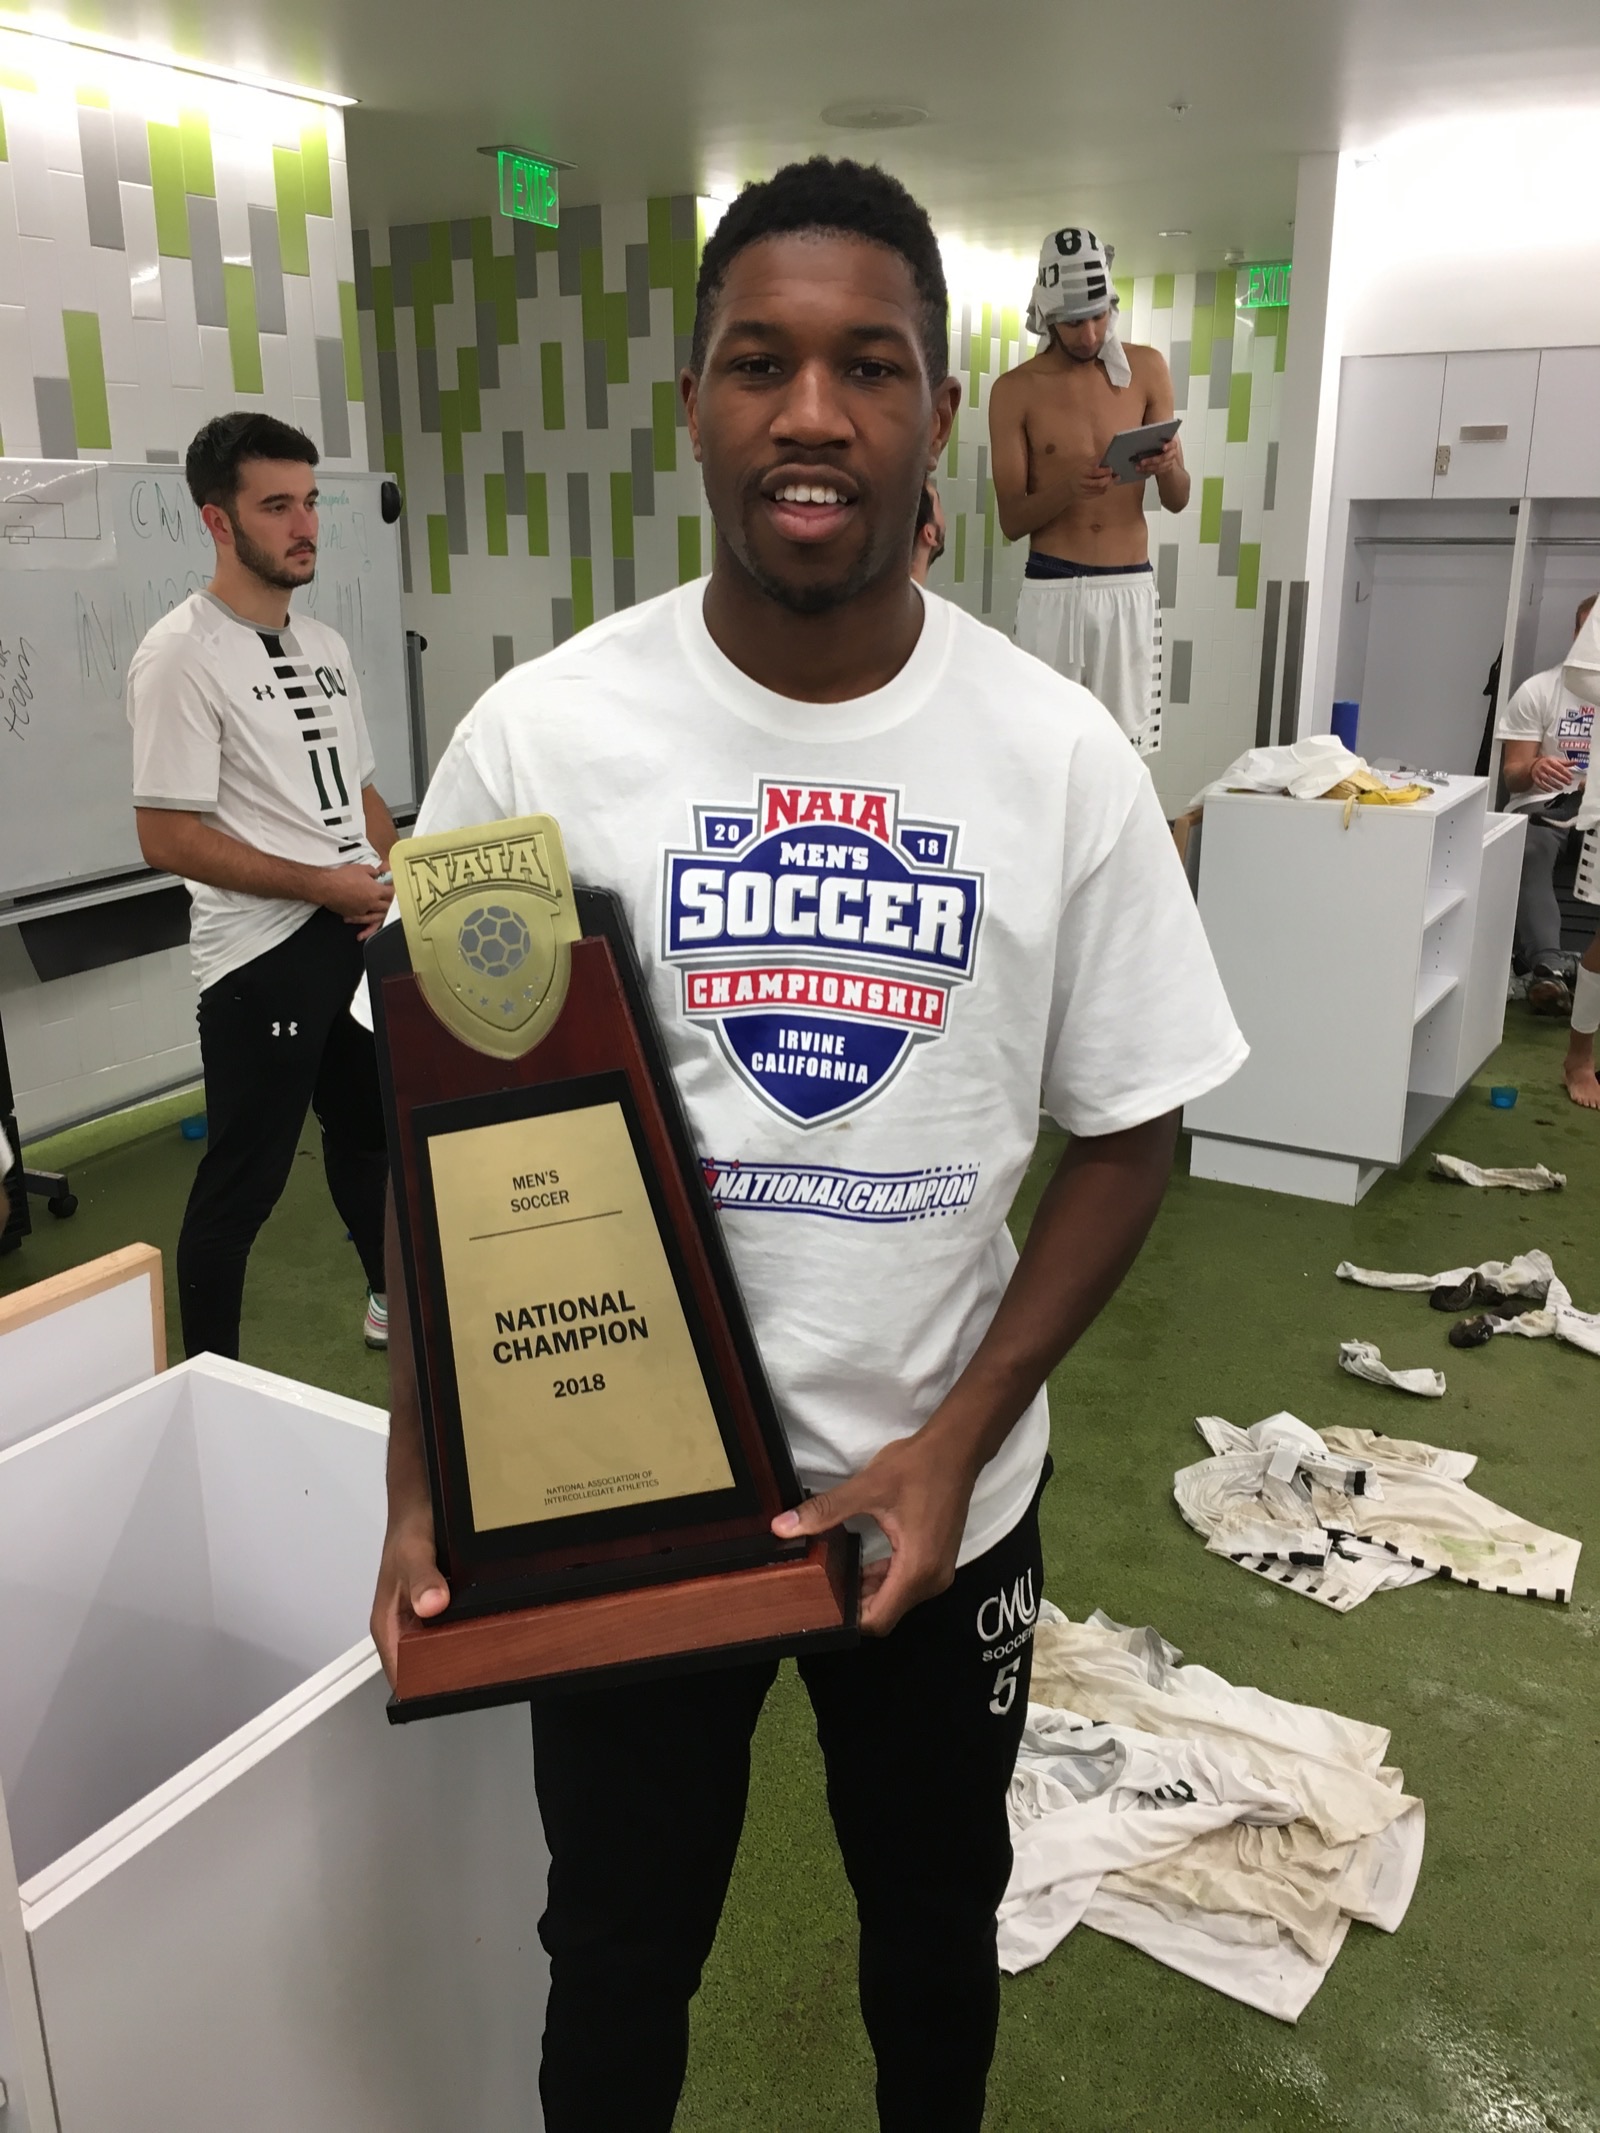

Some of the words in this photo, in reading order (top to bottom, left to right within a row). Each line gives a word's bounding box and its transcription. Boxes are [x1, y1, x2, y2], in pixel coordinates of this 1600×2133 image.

[513, 160, 549, 221] EXIT
[1248, 266, 1292, 306] EXIT
[308, 746, 349, 811] 11
[714, 824, 740, 842] 20
[764, 787, 890, 844] NAIA
[779, 841, 869, 871] MEN'S
[917, 838, 939, 857] 18
[408, 837, 550, 911] NAIA
[679, 868, 967, 961] SOCCER
[693, 973, 940, 1020] CHAMPIONSHIP
[778, 1029, 845, 1056] IRVINE
[751, 1052, 869, 1084] CALIFORNIA
[510, 1190, 570, 1212] SOCCER
[512, 1170, 560, 1191] MEN'S
[711, 1172, 846, 1209] NATIONAL
[846, 1171, 978, 1213] CHAMPION
[495, 1290, 636, 1334] NATIONAL
[493, 1316, 649, 1364] CHAMPION
[553, 1373, 606, 1398] 2018
[544, 1487, 615, 1505] INTERCOLLEGIATE
[616, 1479, 660, 1493] ATHLETICS
[546, 1482, 585, 1495] NATIONAL
[587, 1472, 640, 1488] ASSOCIATION
[642, 1470, 653, 1478] OF
[977, 1567, 1037, 1642] CMU
[989, 1655, 1021, 1716] 5
